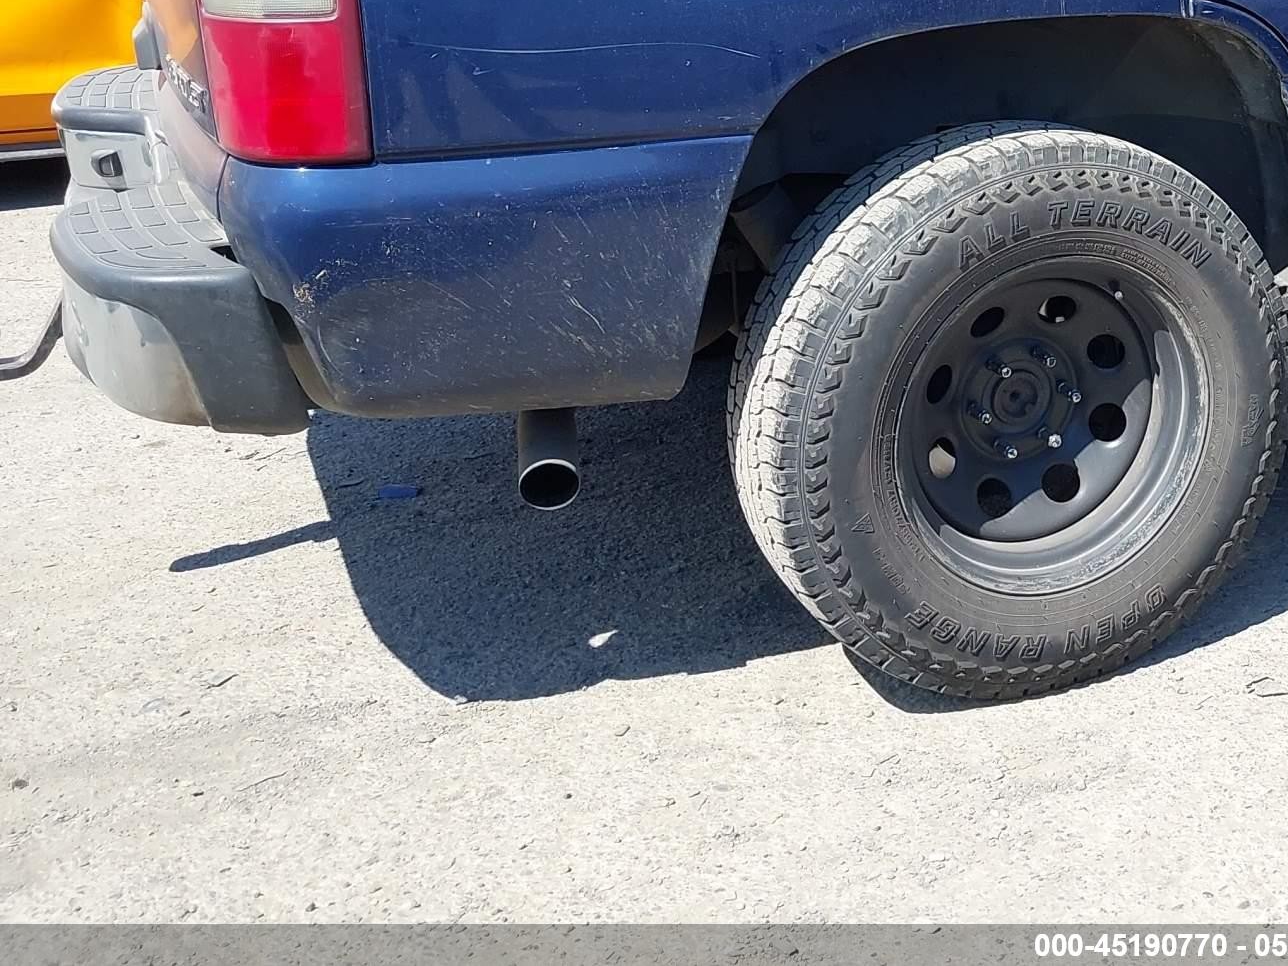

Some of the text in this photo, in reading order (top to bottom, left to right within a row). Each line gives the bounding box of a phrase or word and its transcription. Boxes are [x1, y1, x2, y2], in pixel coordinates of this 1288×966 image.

[959, 211, 1031, 272] ALL
[1047, 199, 1212, 269] TERRAIN
[904, 585, 1168, 661] OPEN RANGE
